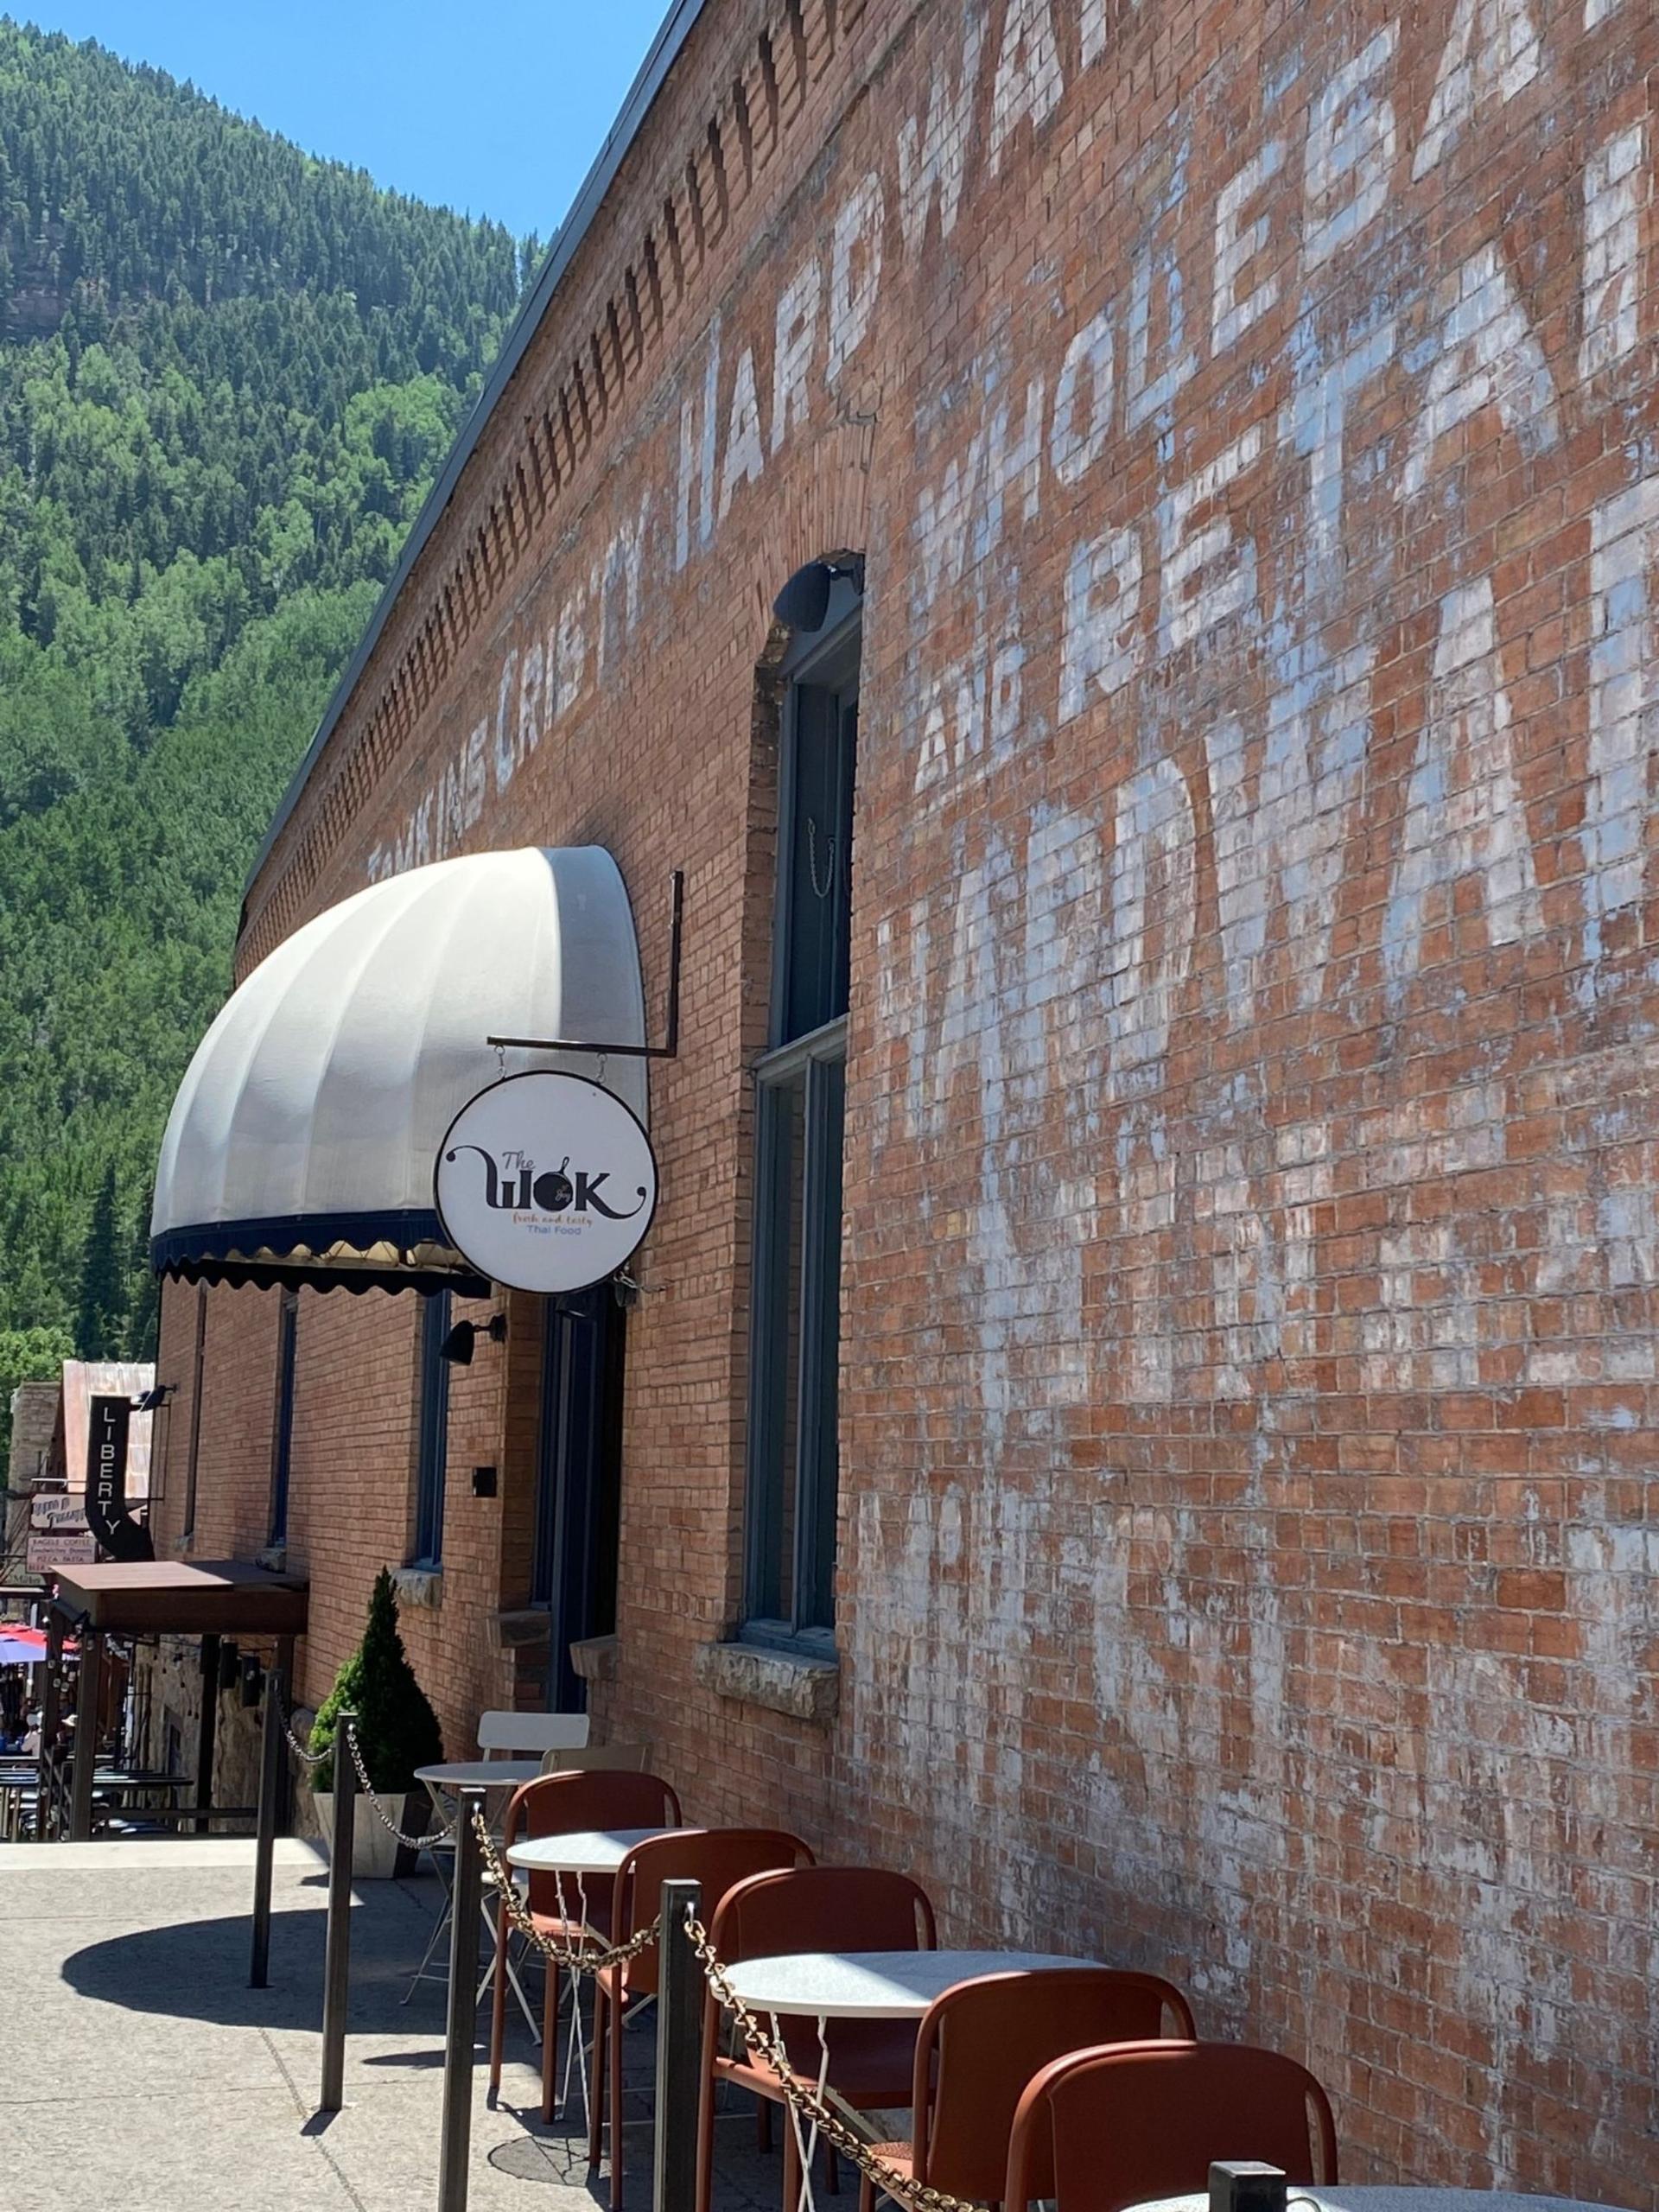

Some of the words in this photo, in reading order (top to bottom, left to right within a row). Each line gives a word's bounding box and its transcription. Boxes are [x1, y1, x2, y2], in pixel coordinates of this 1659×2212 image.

[676, 0, 1108, 572] HARDWA
[912, 0, 1623, 608] WHOLESA
[446, 1145, 646, 1220] WOK
[502, 1150, 536, 1170] The
[512, 1211, 537, 1224] fresh
[542, 1213, 563, 1224] and
[567, 1215, 593, 1228] tasty
[527, 1225, 551, 1234] Thai
[555, 1225, 582, 1236] Food
[97, 1407, 121, 1535] LIBERTY
